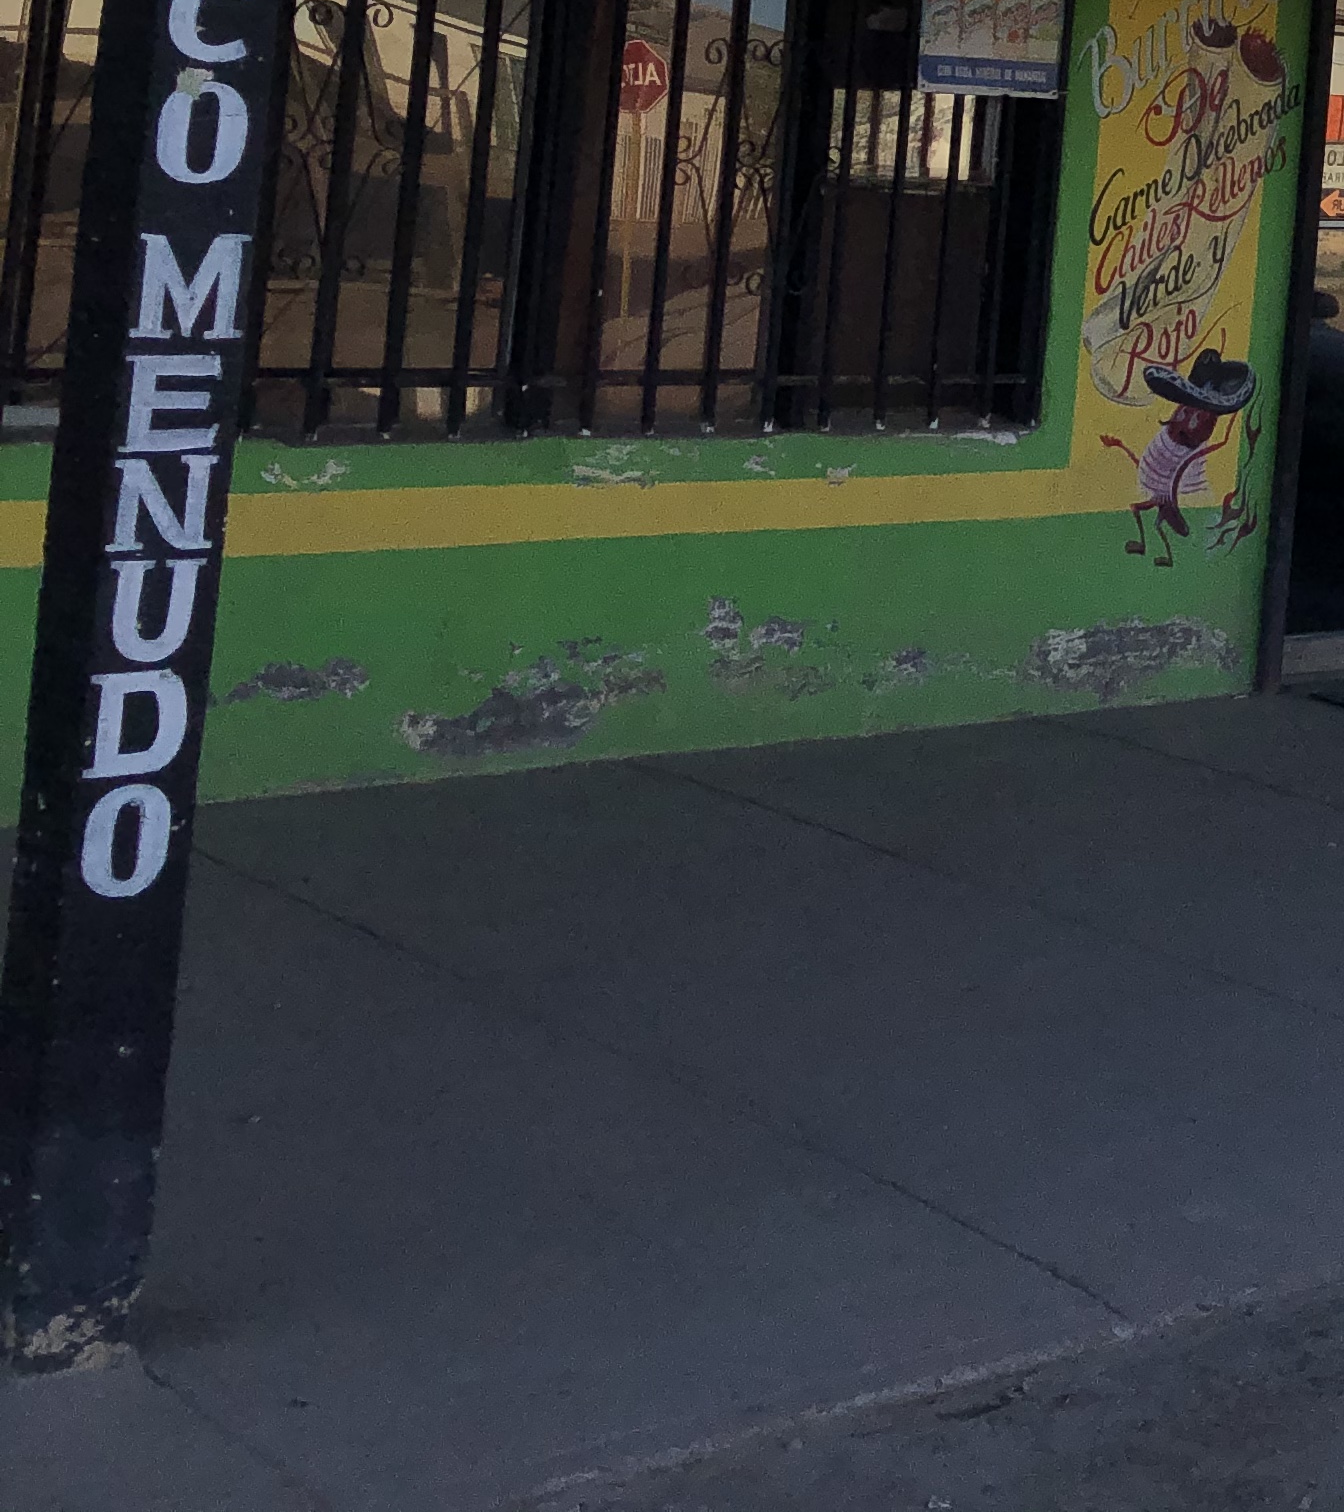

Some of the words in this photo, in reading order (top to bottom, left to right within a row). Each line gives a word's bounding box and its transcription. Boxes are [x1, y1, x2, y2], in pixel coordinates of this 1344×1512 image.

[1089, 168, 1172, 246] Carne
[1094, 208, 1182, 295] Chiles
[1164, 137, 1287, 247] Rellenos
[1118, 246, 1194, 330] Verde
[1112, 303, 1222, 397] Rojo
[80, 232, 252, 899] MENUDO
